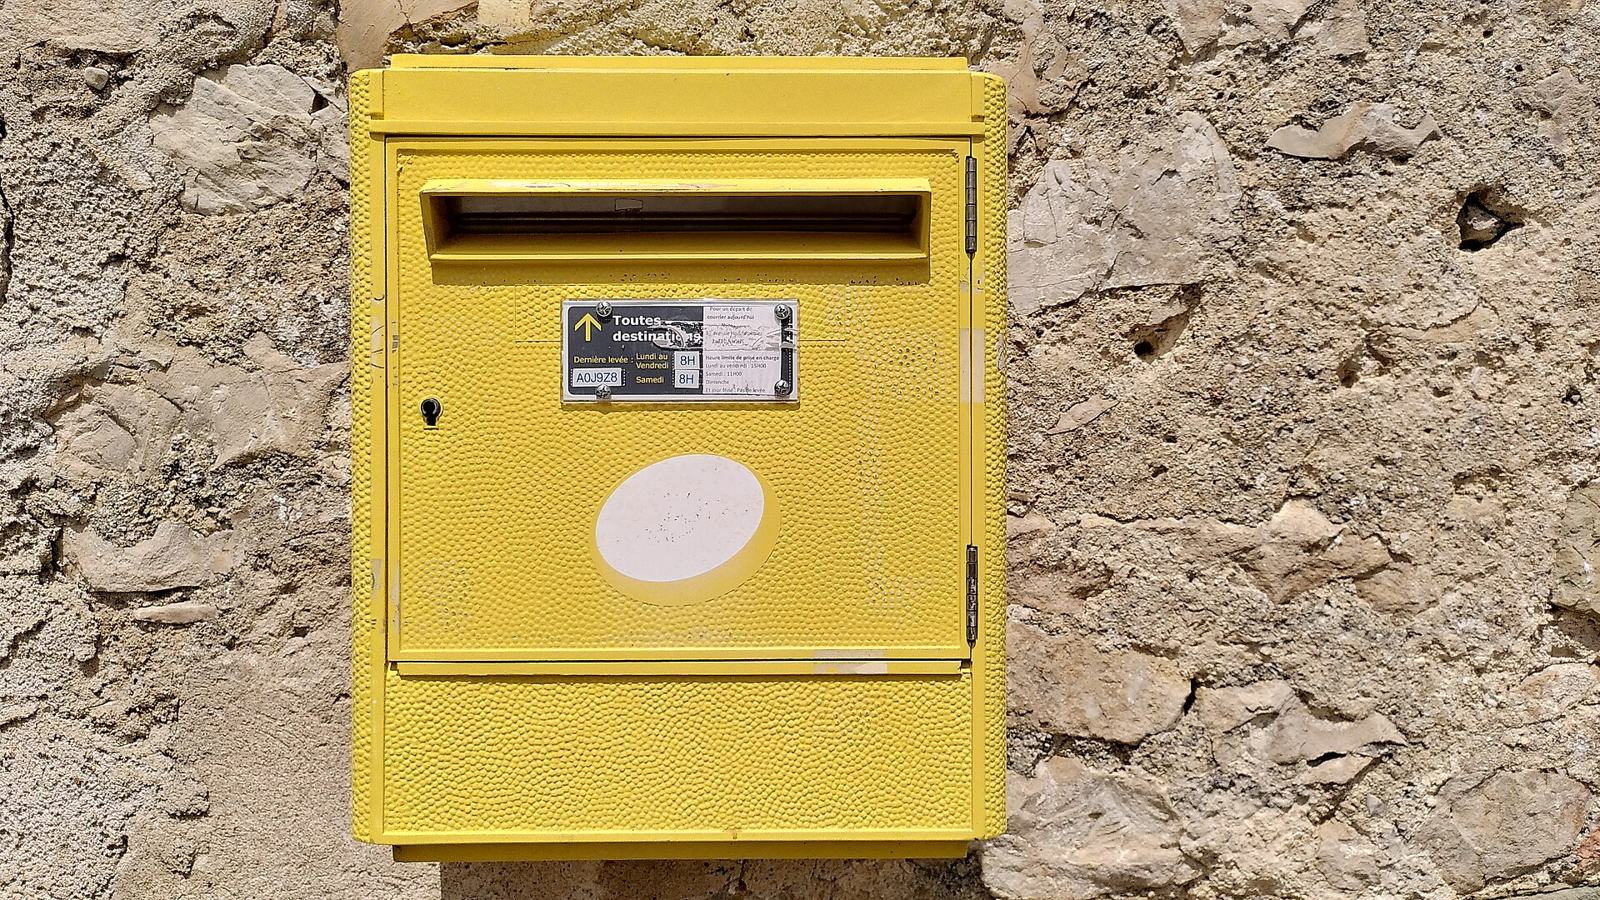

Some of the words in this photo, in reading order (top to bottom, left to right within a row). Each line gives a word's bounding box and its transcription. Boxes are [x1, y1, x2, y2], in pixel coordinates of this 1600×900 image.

[612, 315, 661, 326] Toutes
[573, 355, 607, 364] Dernière
[608, 355, 629, 364] levée
[680, 355, 695, 366] 8H
[576, 372, 618, 383] A0J9Z8
[635, 376, 664, 384] Samedi
[679, 374, 694, 384] 8H
